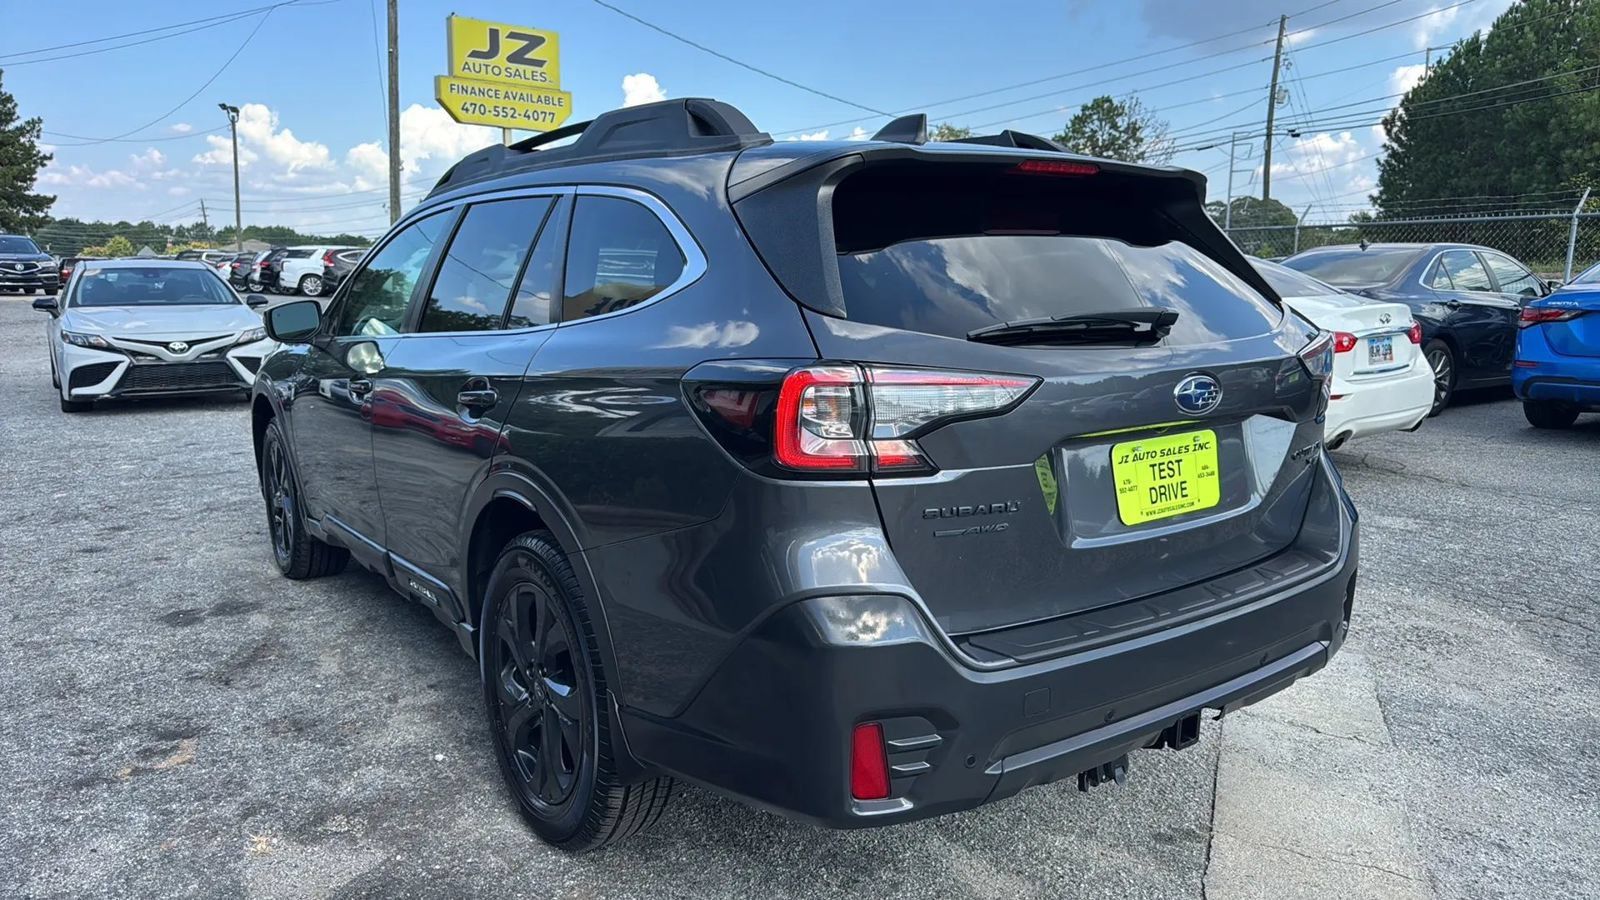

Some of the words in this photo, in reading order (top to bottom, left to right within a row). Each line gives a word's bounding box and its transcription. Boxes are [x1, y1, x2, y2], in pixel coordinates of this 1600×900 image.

[467, 28, 548, 68] JZ
[461, 61, 502, 77] AUTO
[450, 83, 500, 99] FINANCE
[503, 91, 564, 107] AVAILABLE
[461, 102, 556, 123] 470-552-4077
[1118, 454, 1130, 465] JZ
[1132, 450, 1157, 463] AUTO
[1160, 444, 1190, 457] SALES
[1149, 459, 1183, 481] TEST
[1149, 480, 1189, 505] DRIVE
[922, 501, 1021, 520] SUBARU
[964, 522, 1009, 536] AWD
